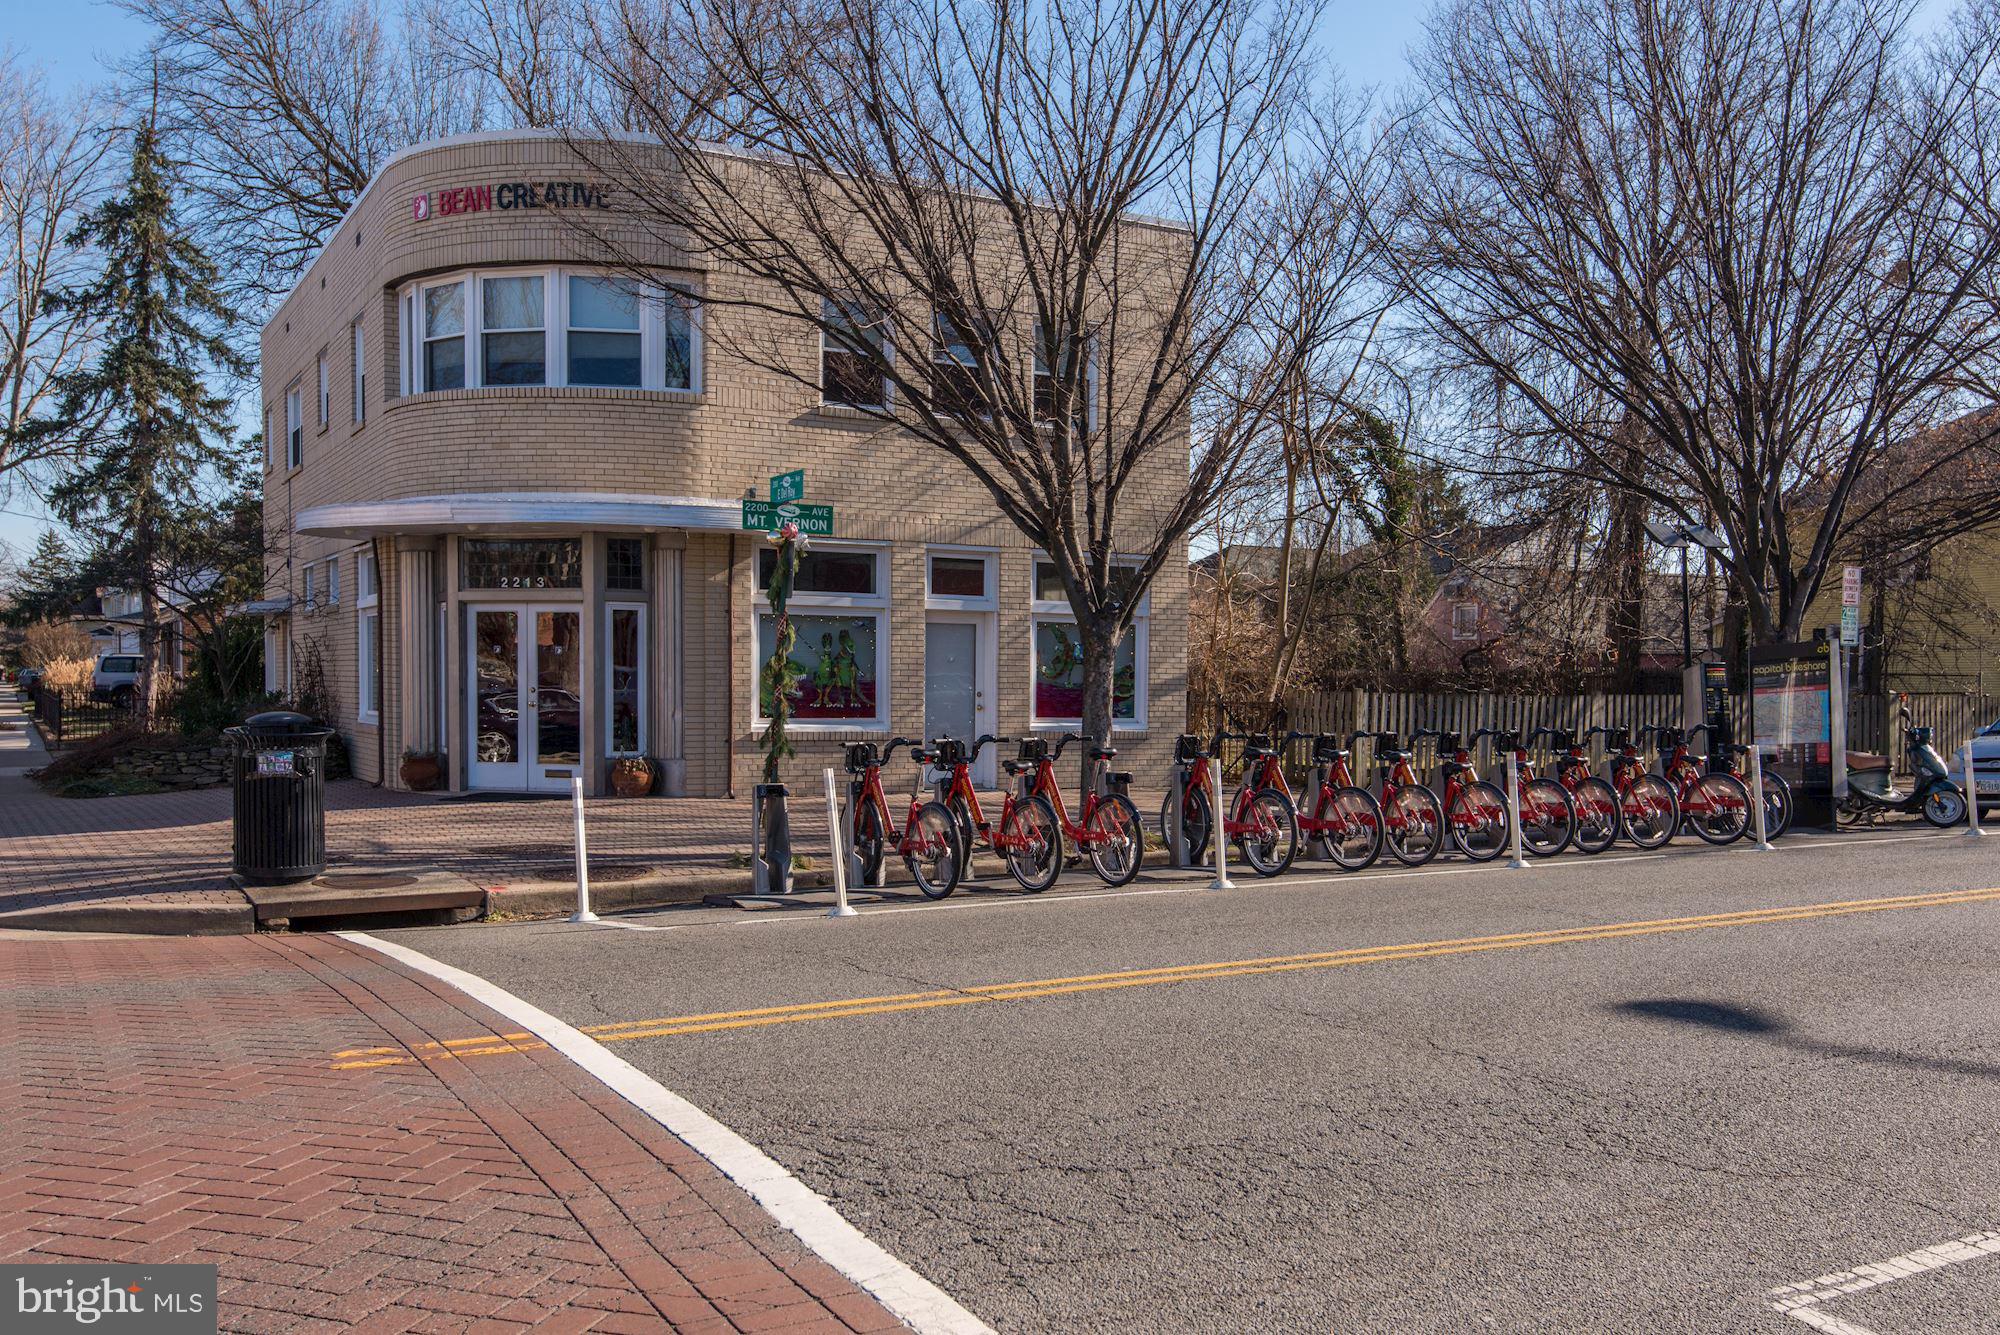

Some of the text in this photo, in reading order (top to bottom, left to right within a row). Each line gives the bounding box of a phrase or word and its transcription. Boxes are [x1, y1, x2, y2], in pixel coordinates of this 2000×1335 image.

[439, 182, 610, 216] BEAN CREATIVE
[745, 502, 829, 517] 2200 AVE
[747, 514, 827, 531] MT. VERNON
[500, 576, 545, 588] 2213
[1752, 661, 1826, 676] capital bikeshare
